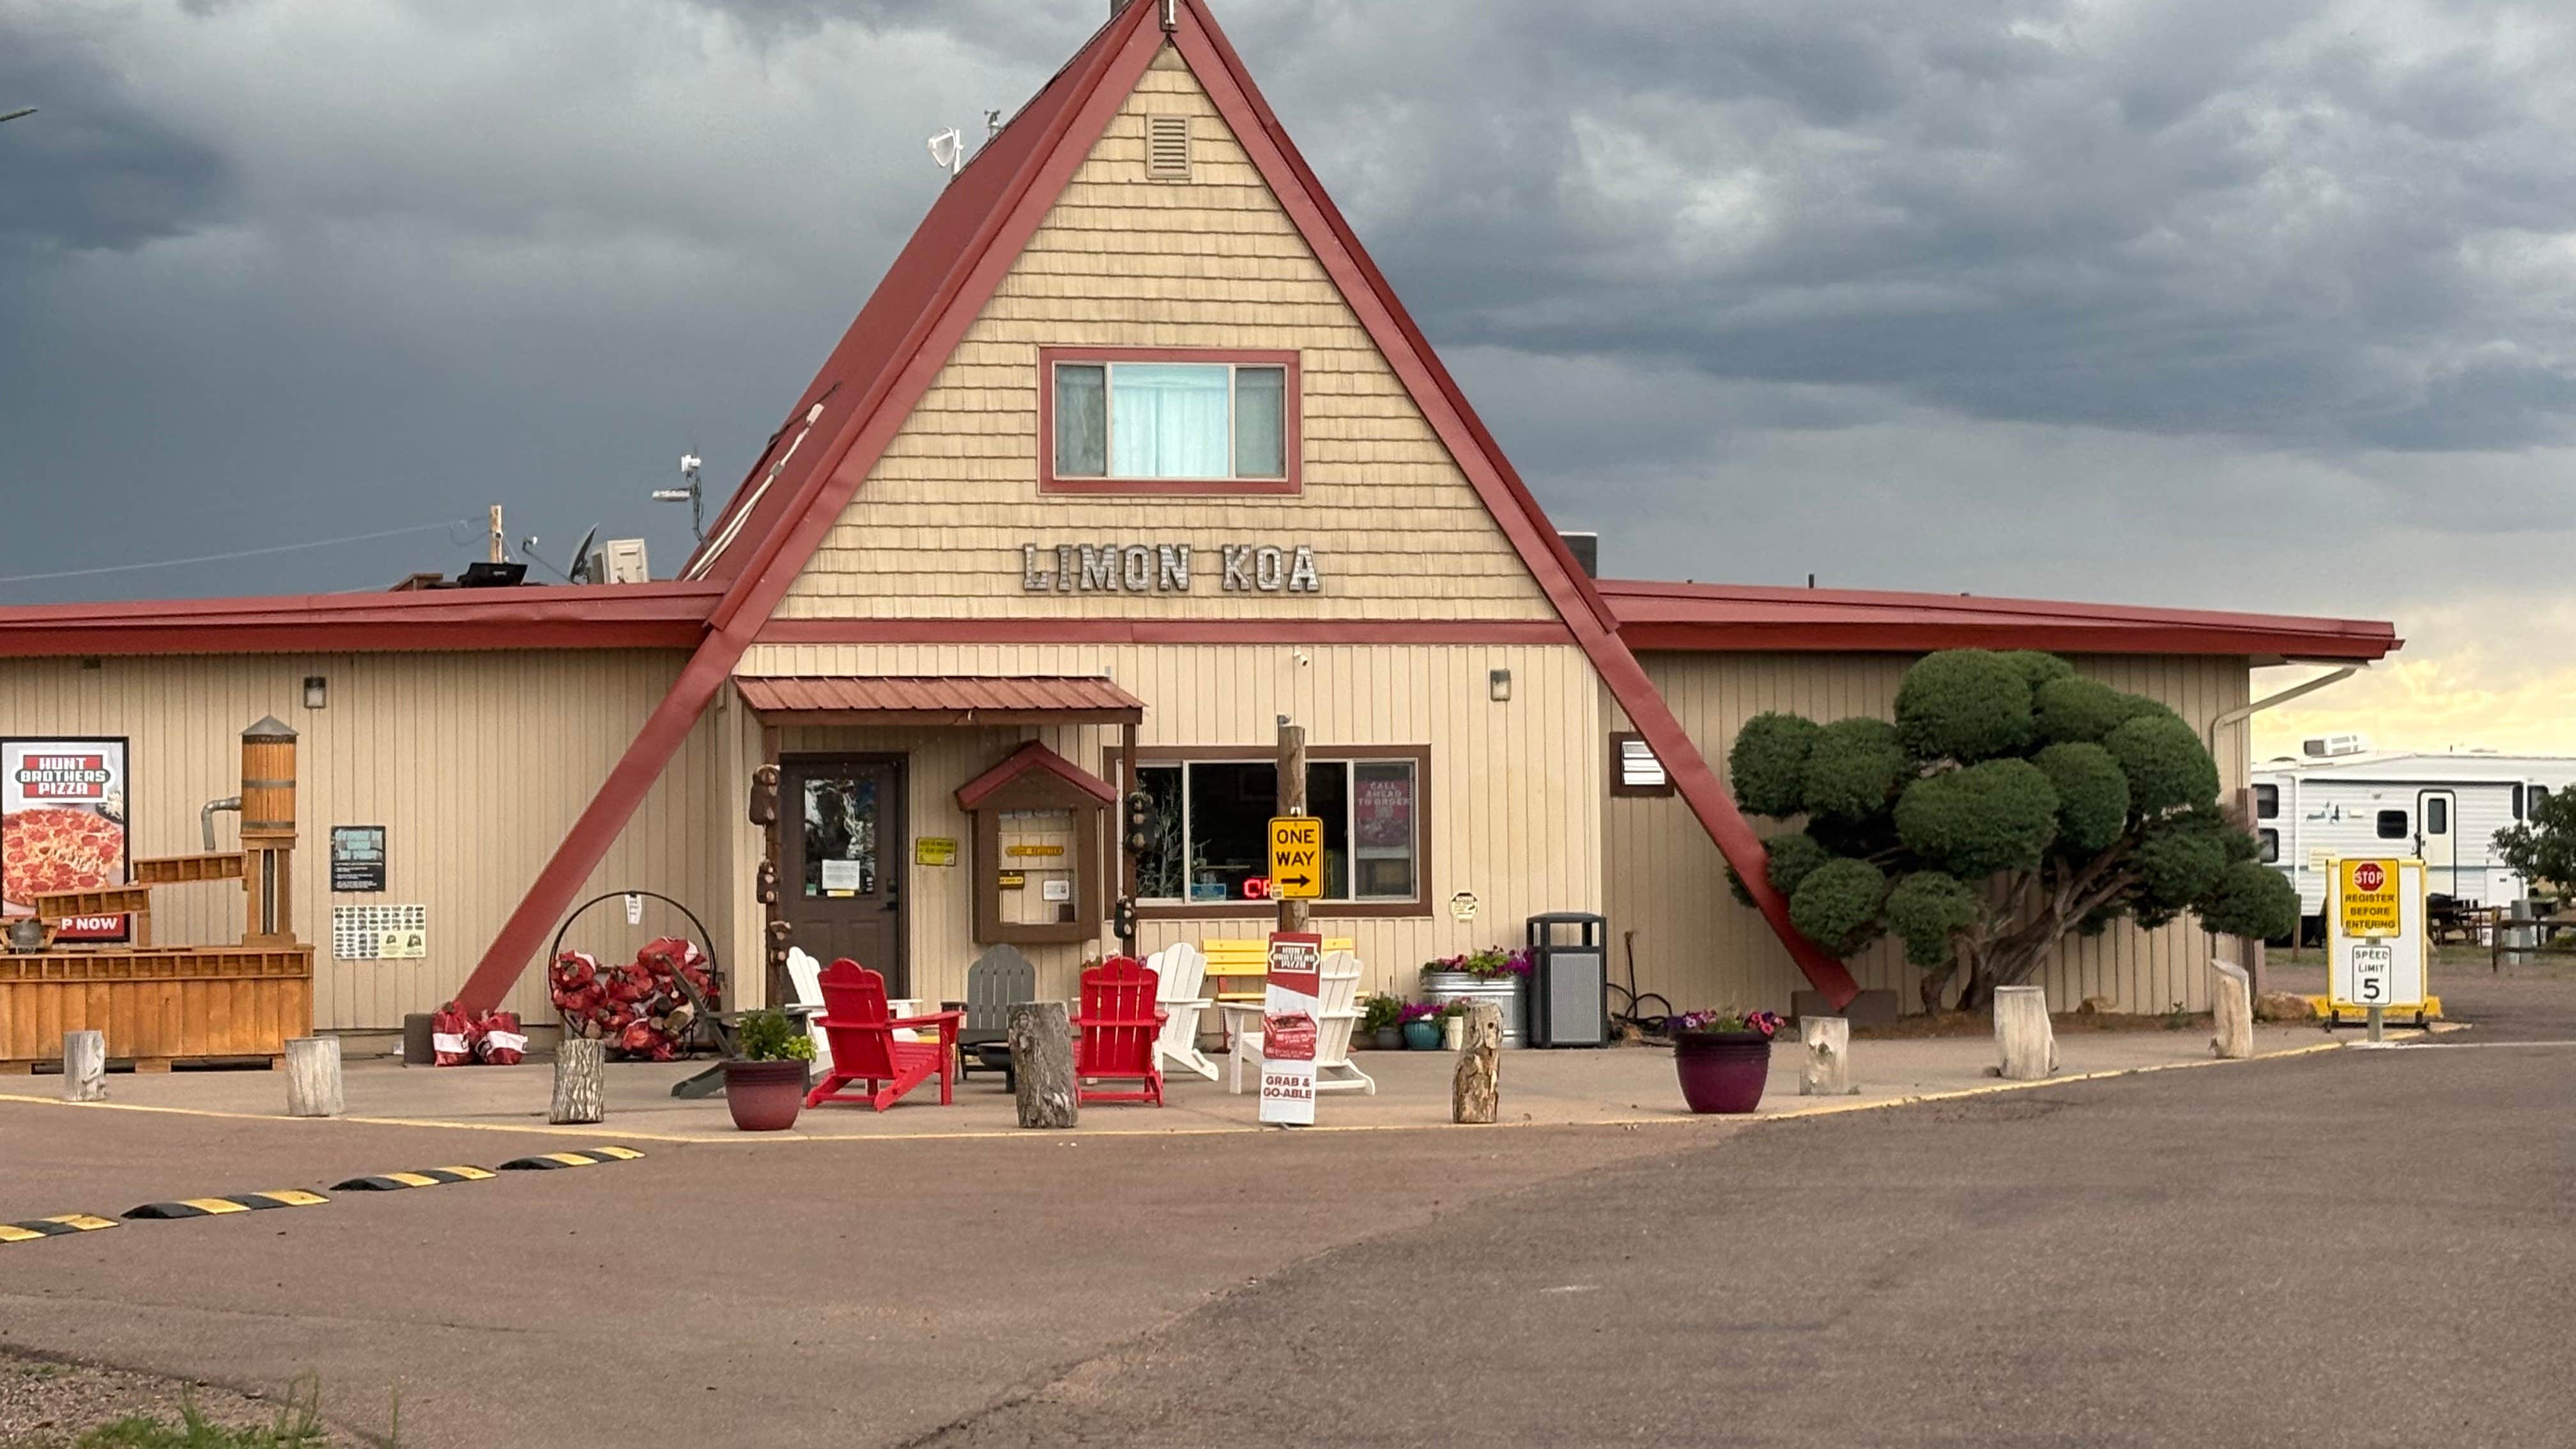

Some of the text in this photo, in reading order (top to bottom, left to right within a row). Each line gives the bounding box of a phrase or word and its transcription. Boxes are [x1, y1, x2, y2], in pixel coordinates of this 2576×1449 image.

[1023, 542, 1321, 592] LIMON KOA
[38, 757, 87, 770] HUNT
[20, 770, 106, 783] BROTHERS
[38, 782, 88, 795] PIZZA
[1370, 781, 1398, 790] CALL
[1365, 790, 1402, 798] AHEAD
[1276, 829, 1315, 844] ONE
[1276, 851, 1315, 866] WAY
[2354, 871, 2384, 884] STOP
[2345, 894, 2395, 903] REGISTER
[2350, 907, 2390, 916] BEFORE
[76, 917, 118, 930] NOW
[2356, 950, 2388, 959] SPEED
[2358, 963, 2384, 972] LIMIT
[2363, 978, 2380, 999] 5
[1266, 1076, 1310, 1087] GRAB &
[1263, 1087, 1312, 1099] GO-ABLE
